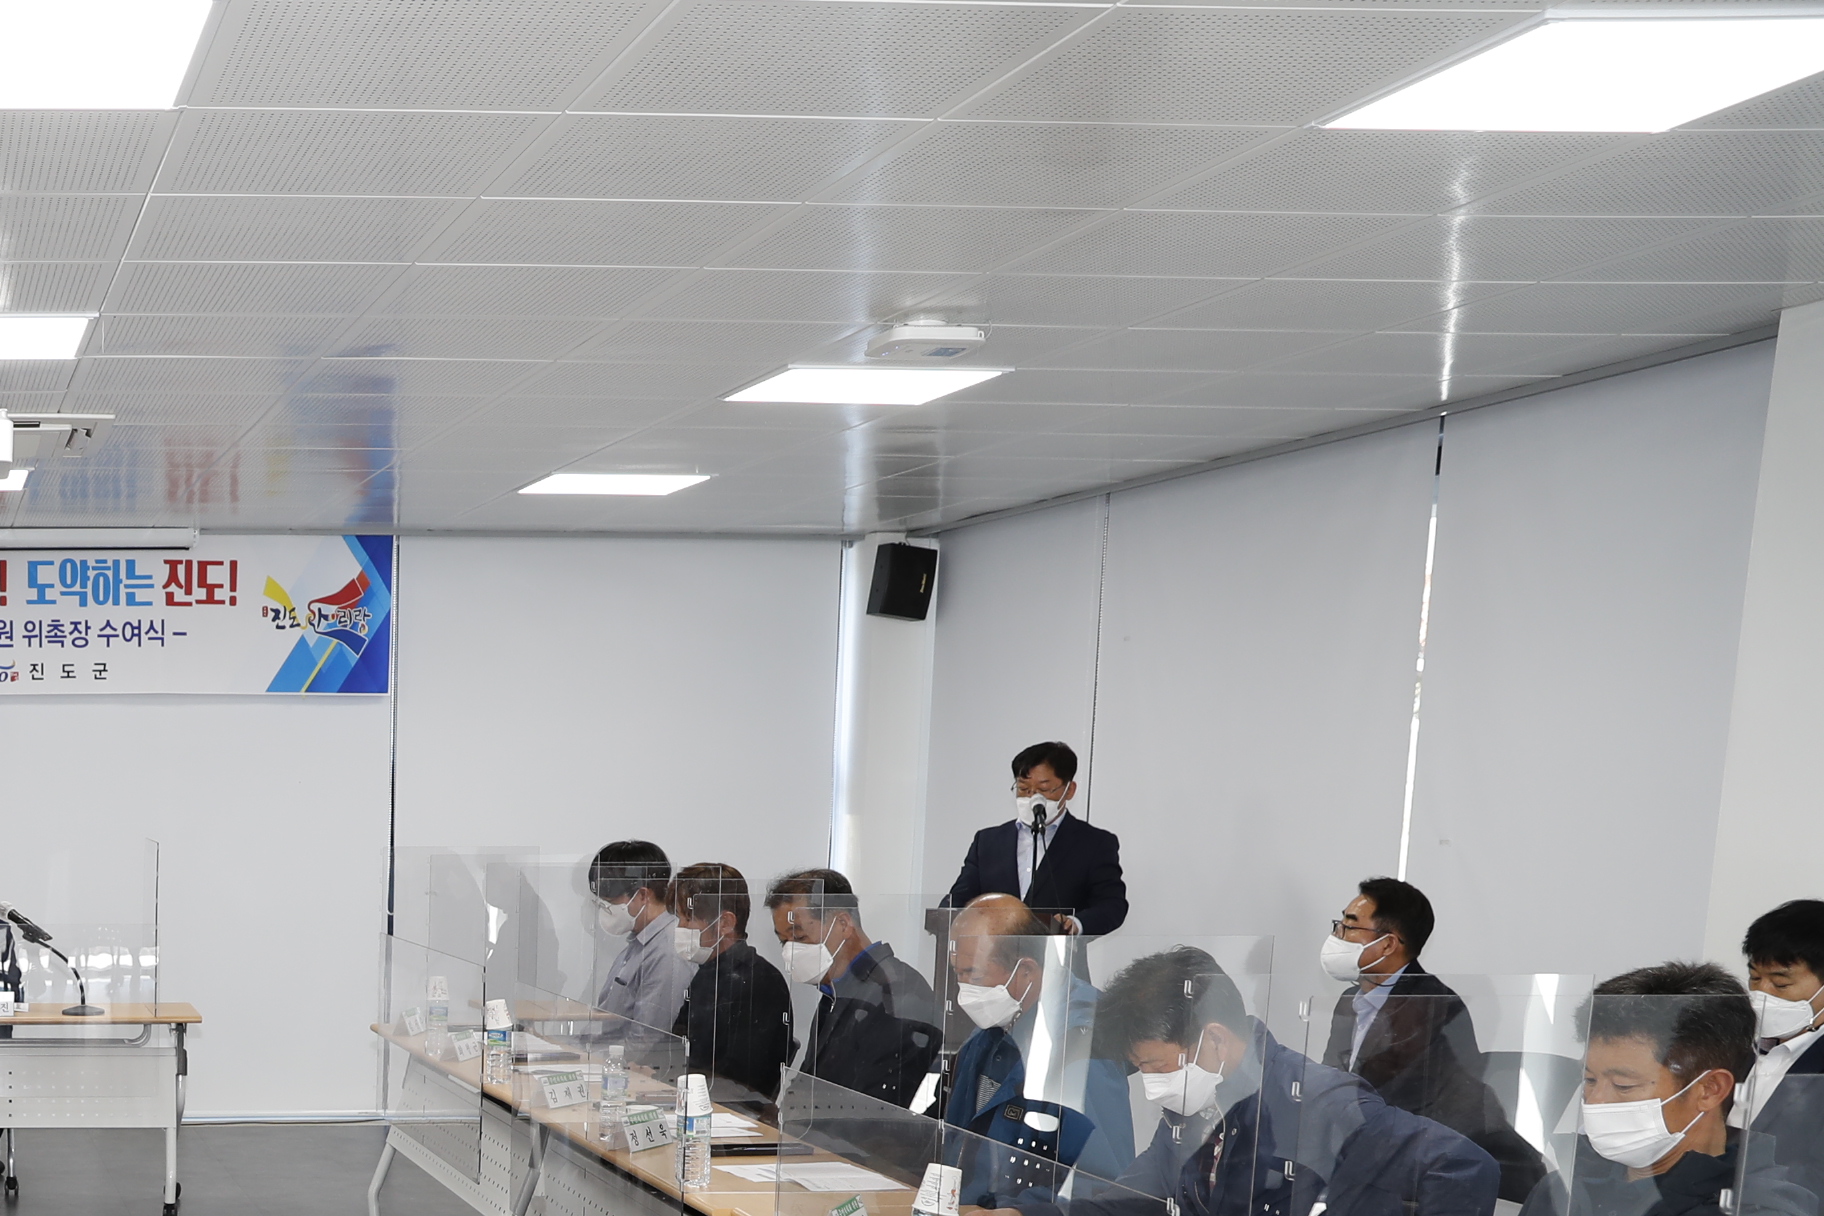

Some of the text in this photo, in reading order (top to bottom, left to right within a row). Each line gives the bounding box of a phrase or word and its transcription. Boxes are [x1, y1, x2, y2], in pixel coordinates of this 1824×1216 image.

[26, 558, 155, 607] 도약하는
[162, 559, 239, 607] 진도!
[22, 618, 91, 648] 위촉장
[96, 618, 165, 648] 수여식
[269, 606, 301, 630] 진도
